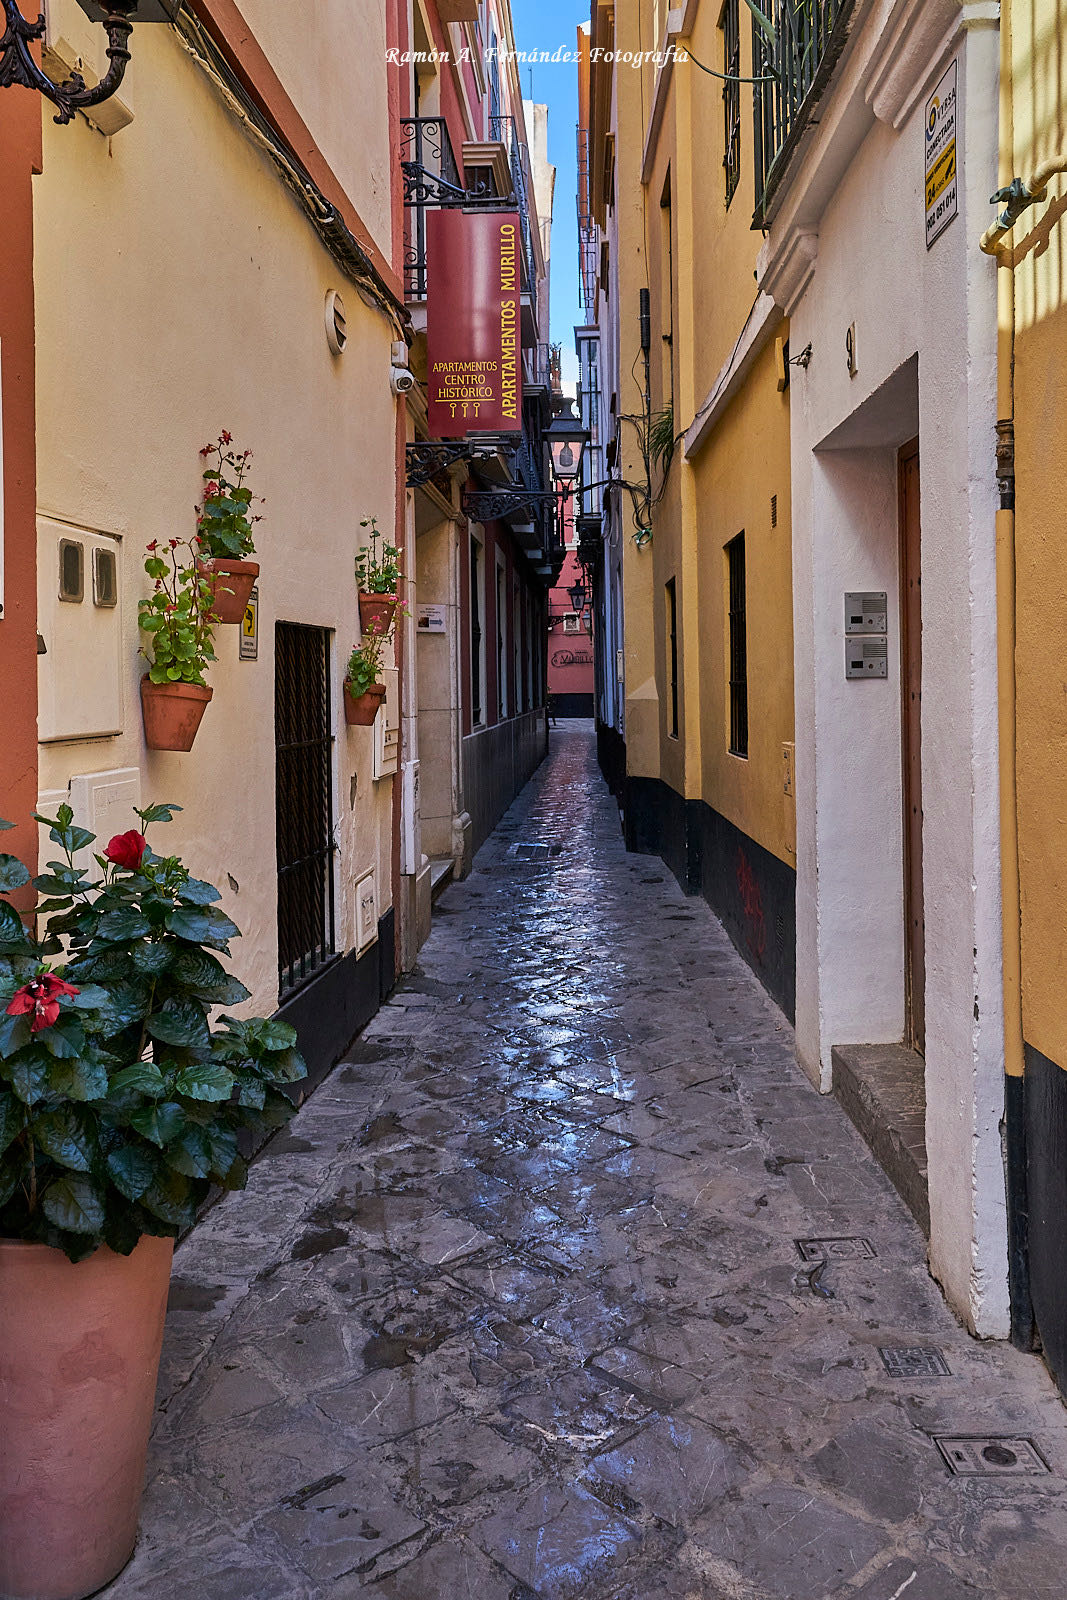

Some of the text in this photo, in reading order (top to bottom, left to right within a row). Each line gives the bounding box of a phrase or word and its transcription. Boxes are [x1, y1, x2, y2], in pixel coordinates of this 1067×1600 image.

[926, 114, 954, 160] CONECTADA
[927, 182, 935, 206] 24
[927, 212, 936, 232] 902
[936, 199, 946, 220] 051
[945, 187, 955, 209] 014
[500, 223, 517, 419] APARTAMENTOS MURILLO
[432, 360, 498, 373] APARTAMENTOS
[438, 385, 493, 399] HISTÓRICO
[444, 374, 486, 386] CENTRO
